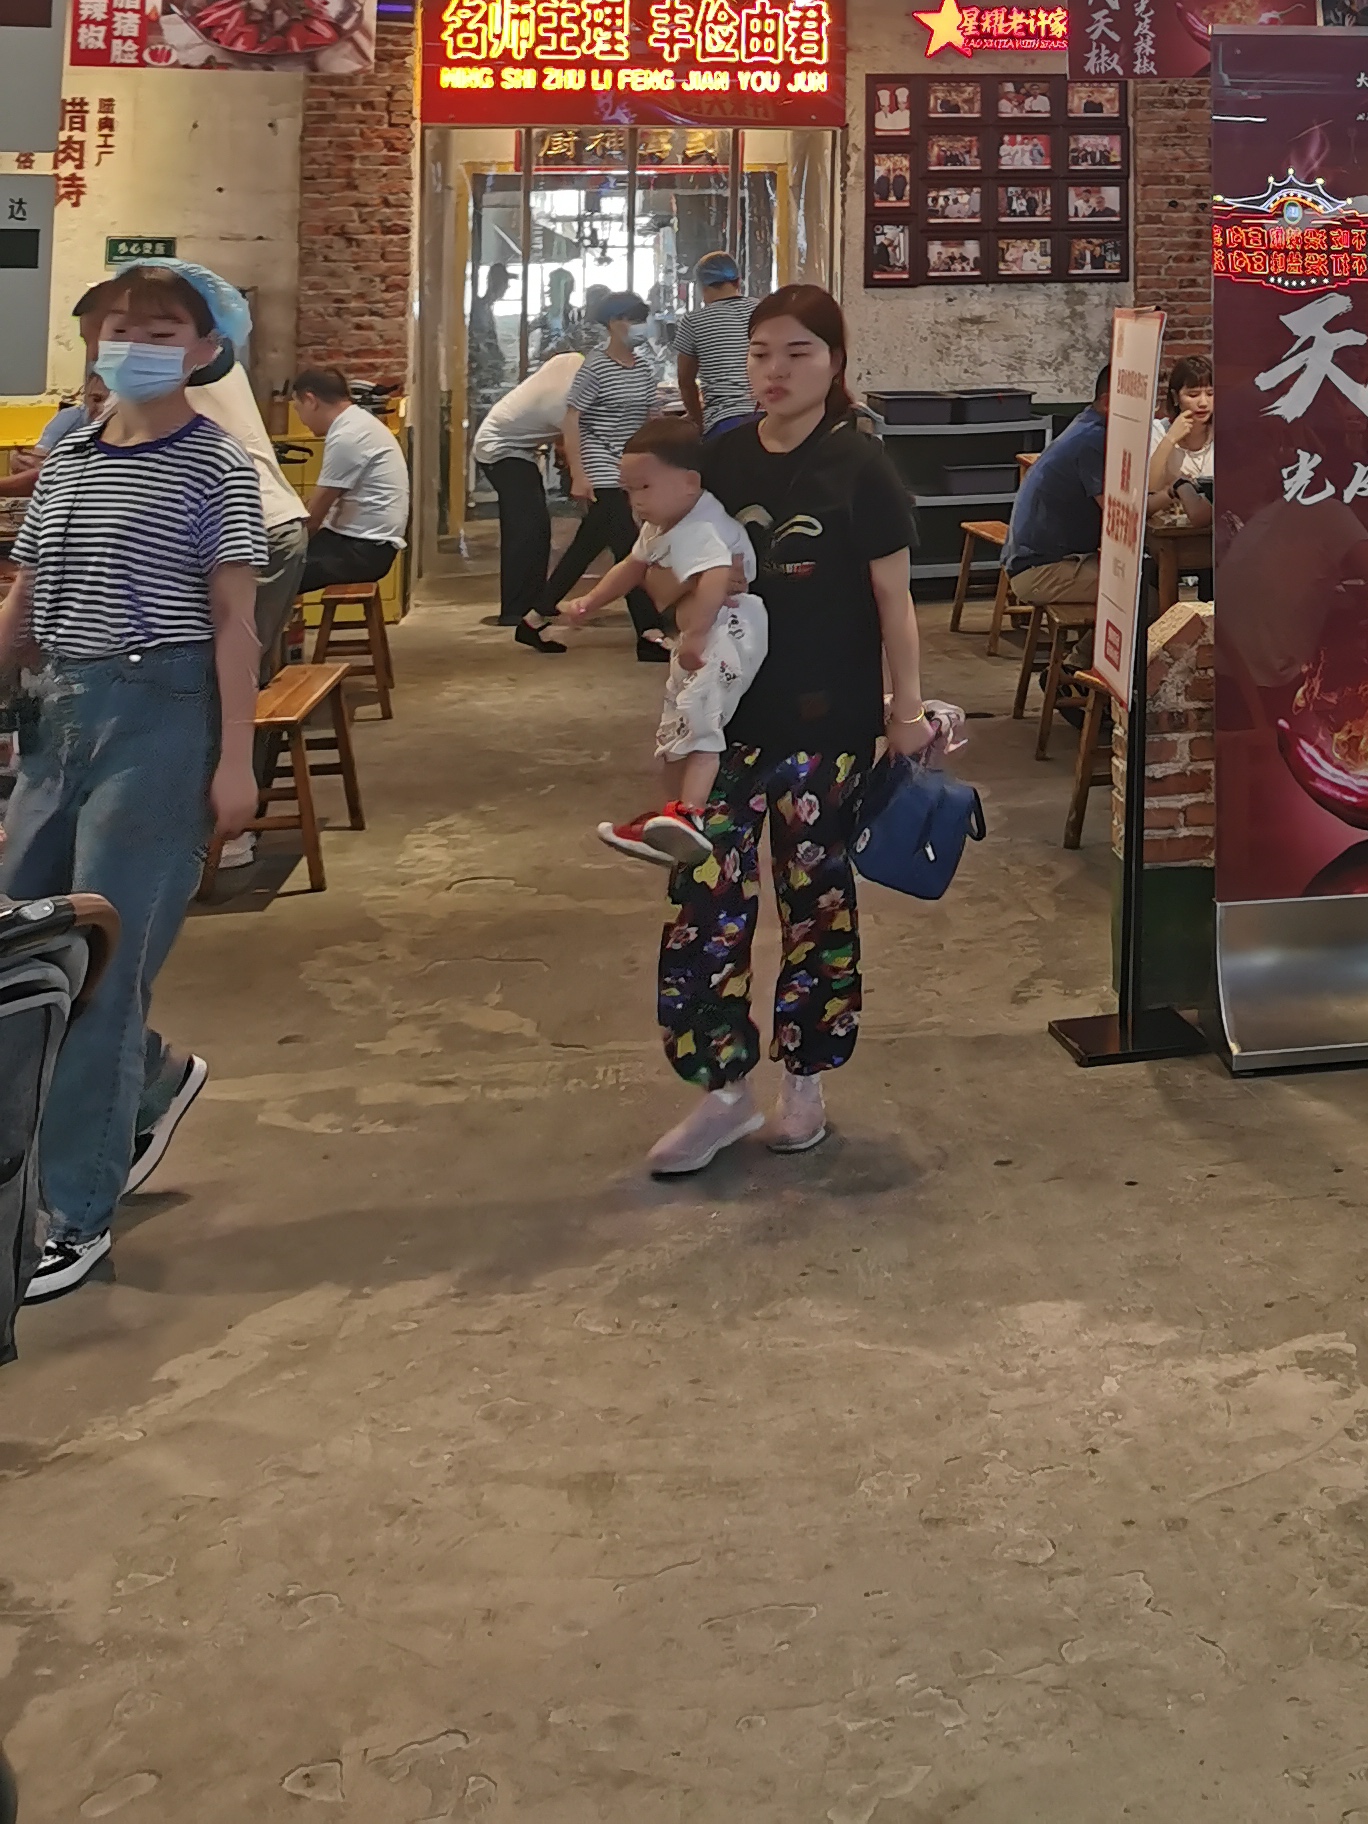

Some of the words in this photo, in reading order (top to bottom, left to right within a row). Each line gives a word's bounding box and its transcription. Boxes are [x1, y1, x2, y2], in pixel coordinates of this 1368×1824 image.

[960, 6, 1068, 38] 星耀老许家
[500, 67, 538, 90] SHI
[542, 67, 587, 91] ZHU
[591, 68, 613, 91] LI
[617, 68, 676, 92] FENG
[738, 69, 781, 93] YOU
[786, 71, 829, 93] JUN
[9, 198, 28, 222] 达
